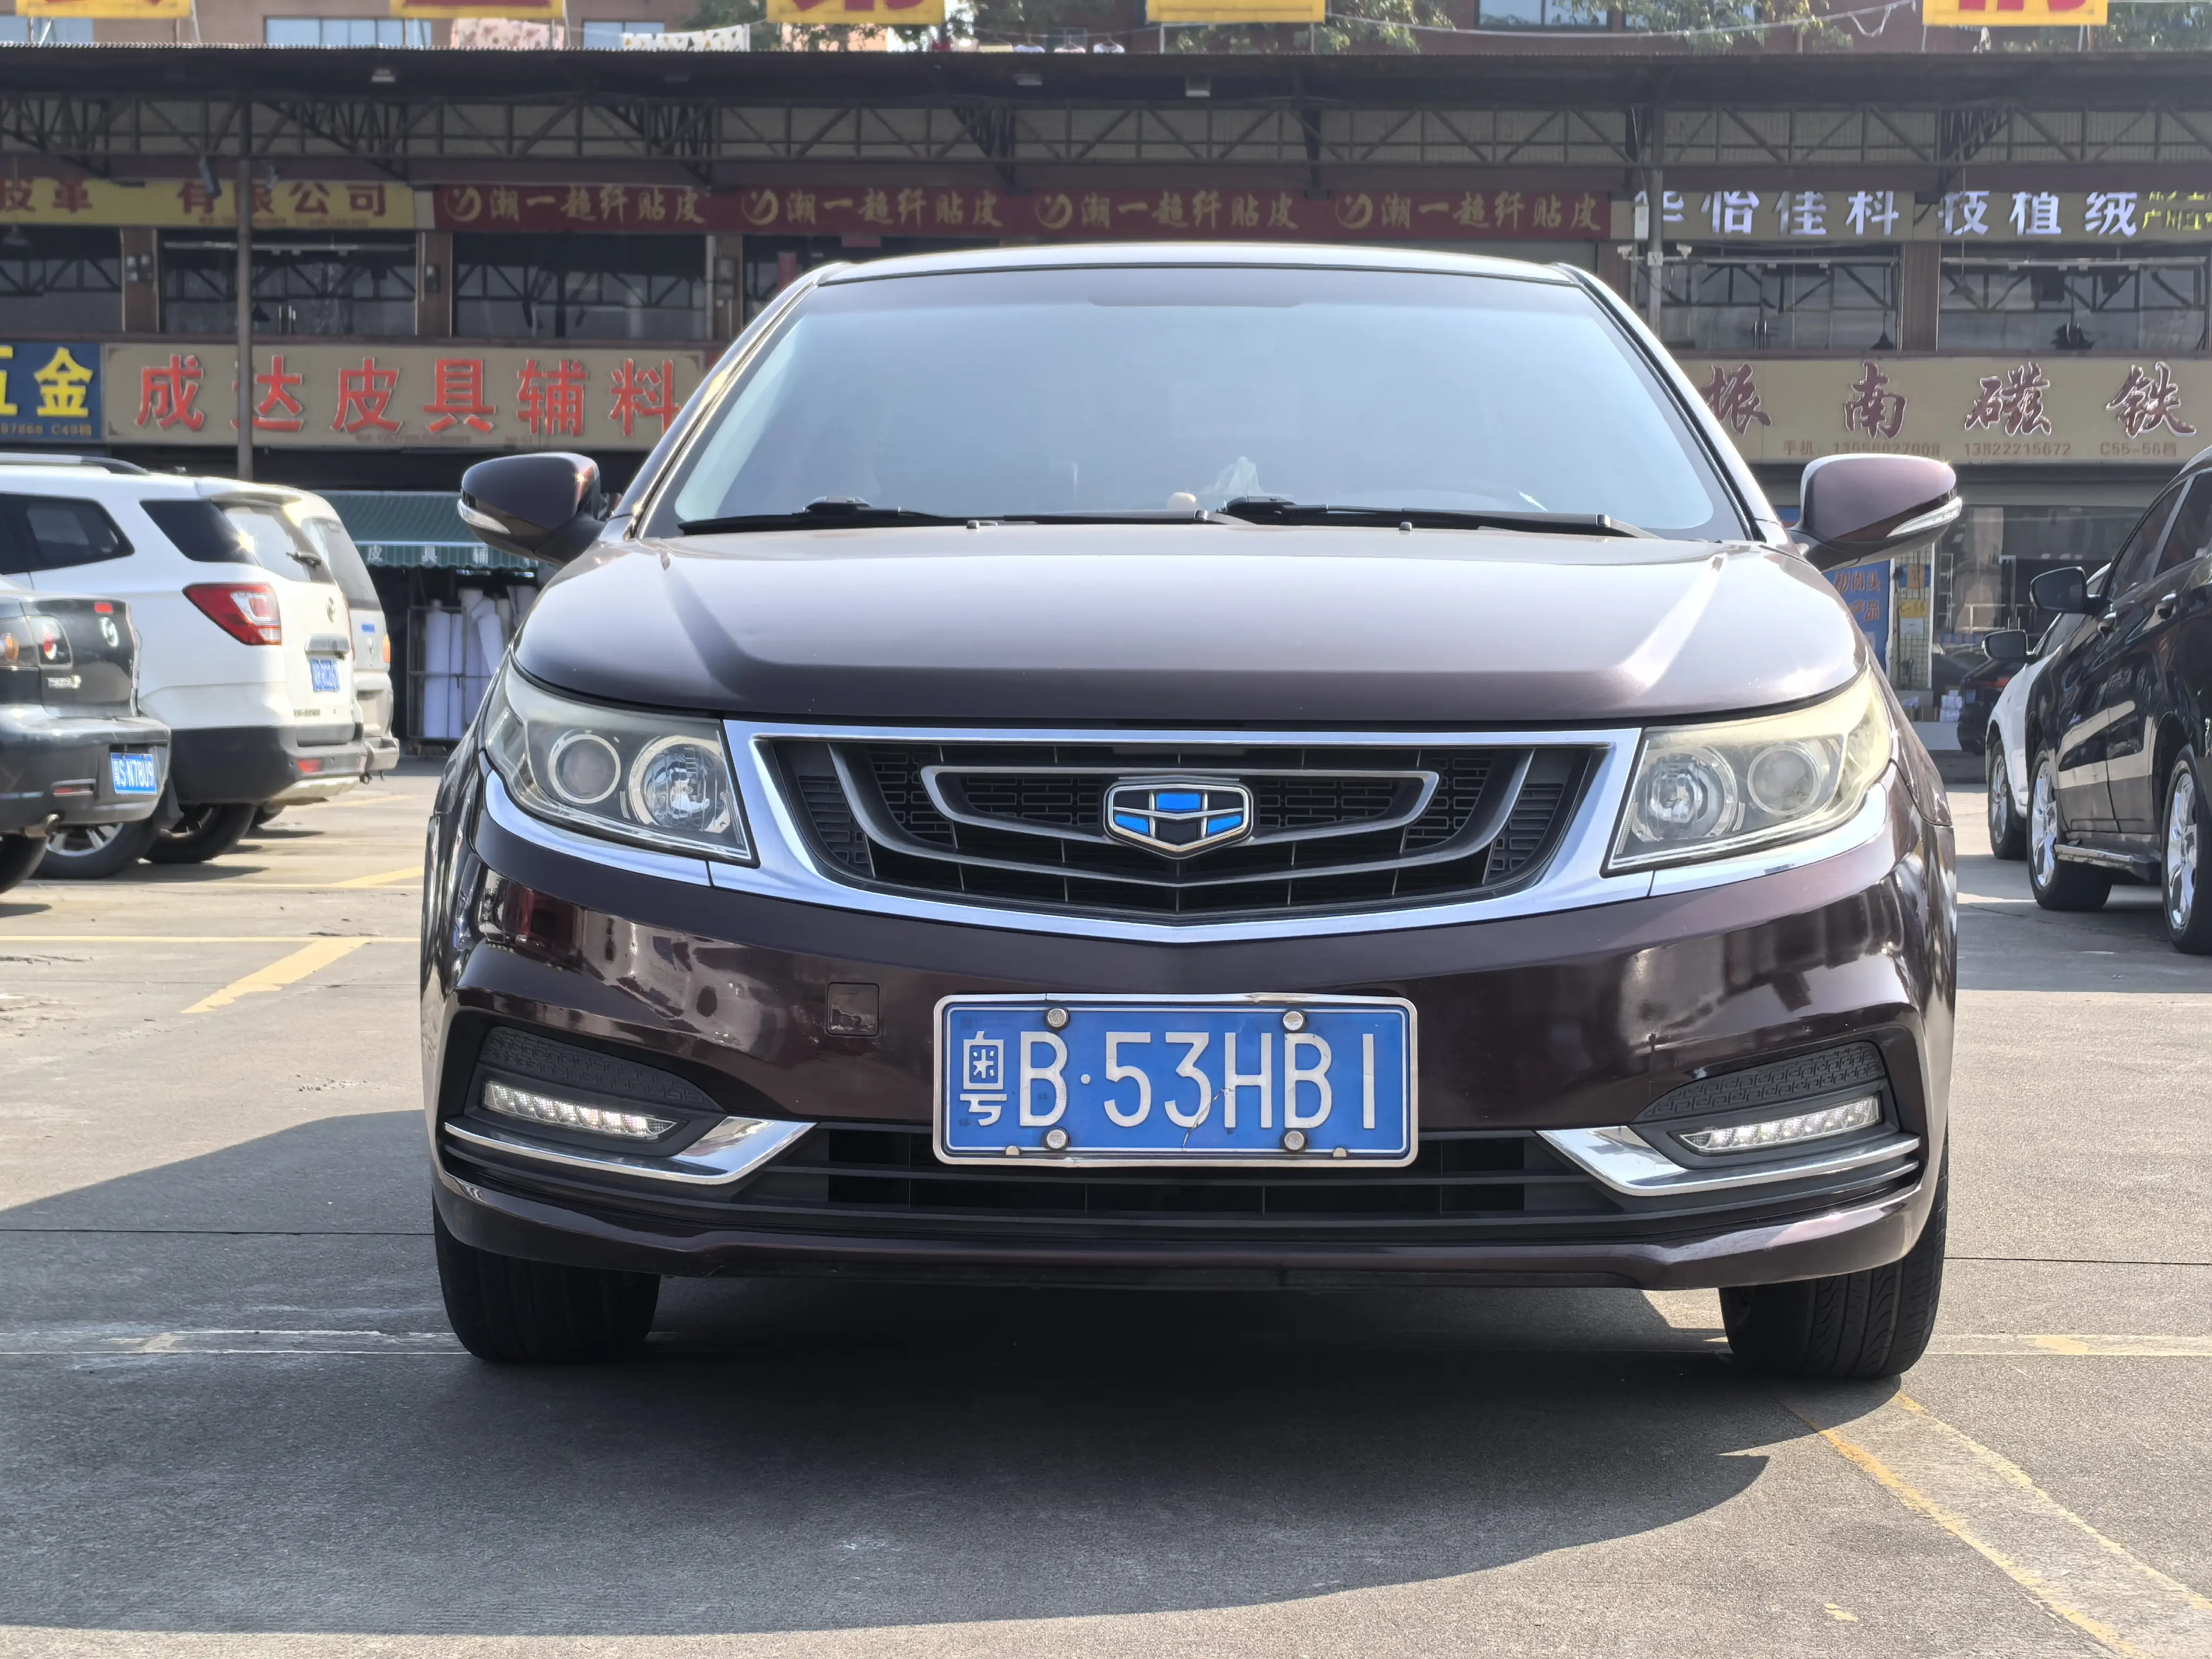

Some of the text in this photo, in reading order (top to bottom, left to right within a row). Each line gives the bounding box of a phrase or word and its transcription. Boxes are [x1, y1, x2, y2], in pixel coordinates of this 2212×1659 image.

[134, 354, 681, 436] 成达皮具辅料
